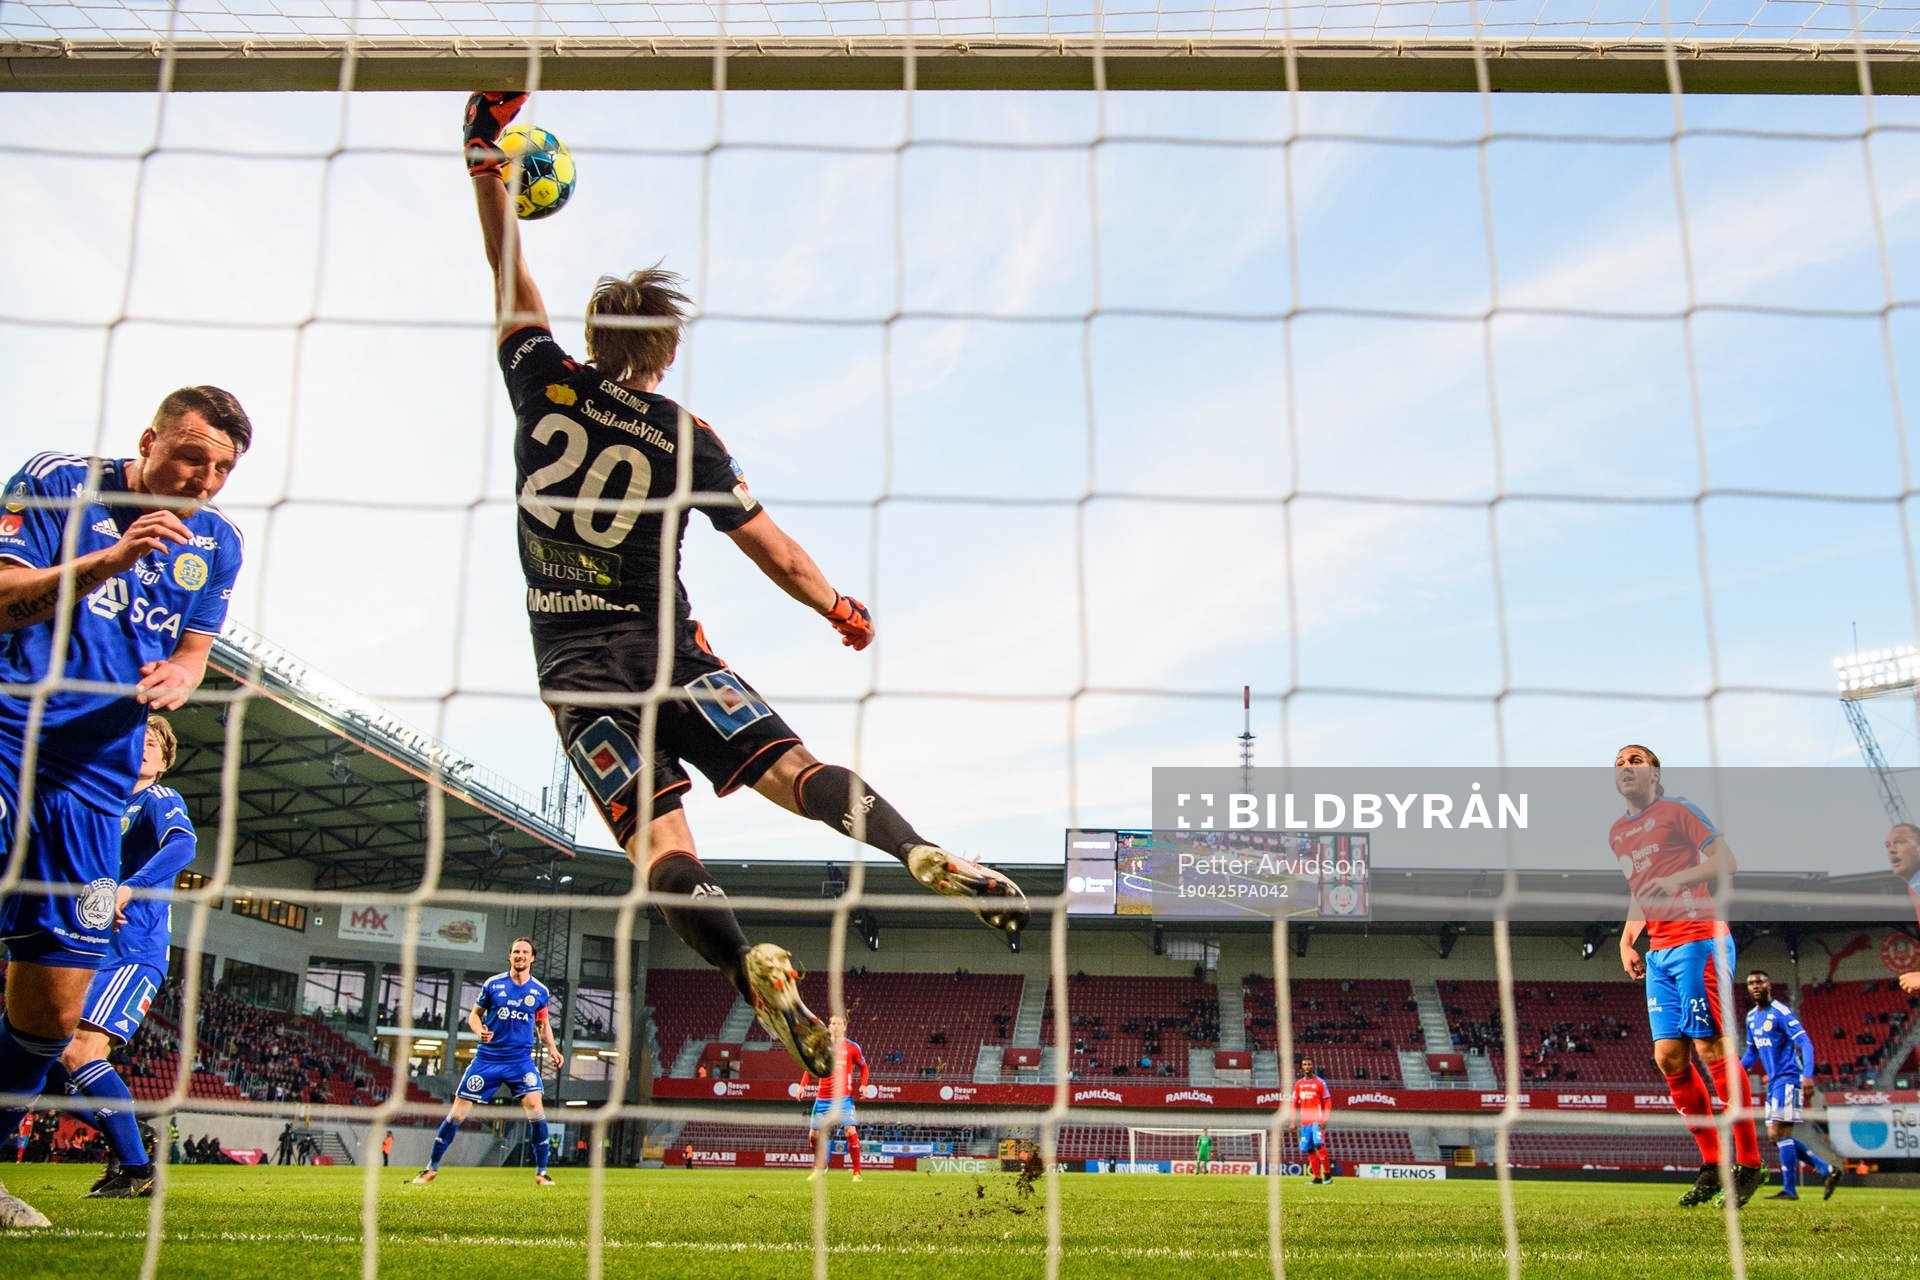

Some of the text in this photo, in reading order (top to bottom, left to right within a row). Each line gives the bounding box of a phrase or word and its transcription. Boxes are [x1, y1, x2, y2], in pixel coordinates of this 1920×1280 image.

[600, 379, 650, 415] ESKELINEN
[521, 413, 652, 549] 20
[542, 562, 598, 583] HUSET
[130, 597, 181, 639] SCA
[350, 905, 390, 931] MAX
[511, 1010, 529, 1021] SCA
[1074, 1088, 1122, 1103] RAMLÖSA
[1165, 1089, 1213, 1104] RAMLÖSA
[1347, 1091, 1396, 1106] RAMLÖSA
[1844, 1092, 1890, 1105] Scandic
[931, 1159, 986, 1173] VINGE
[1384, 1168, 1436, 1180] TEKNOS
